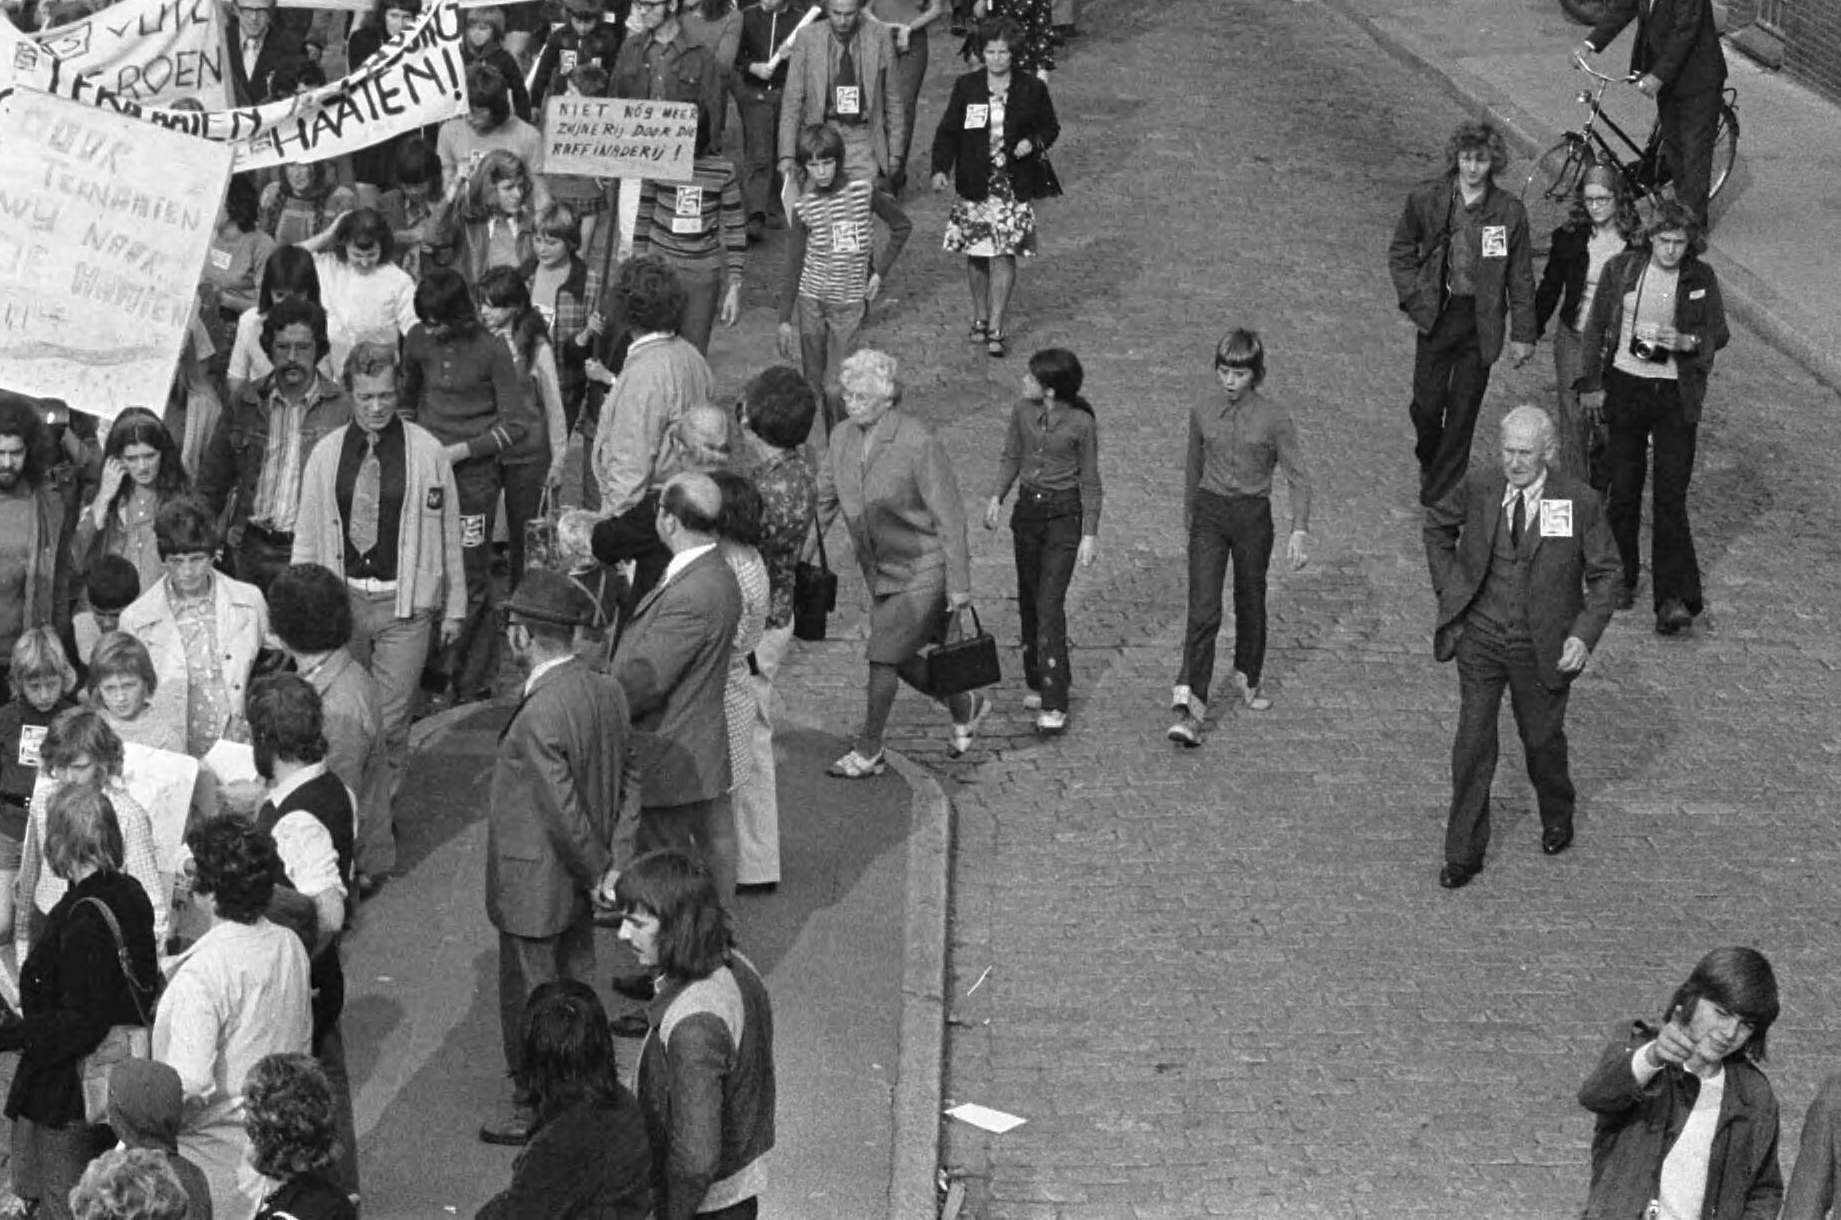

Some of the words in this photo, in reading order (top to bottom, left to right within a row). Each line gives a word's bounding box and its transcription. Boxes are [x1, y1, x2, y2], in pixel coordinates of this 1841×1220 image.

[559, 102, 609, 117] NIET
[662, 106, 698, 120] MEER
[631, 124, 671, 138] DOOR
